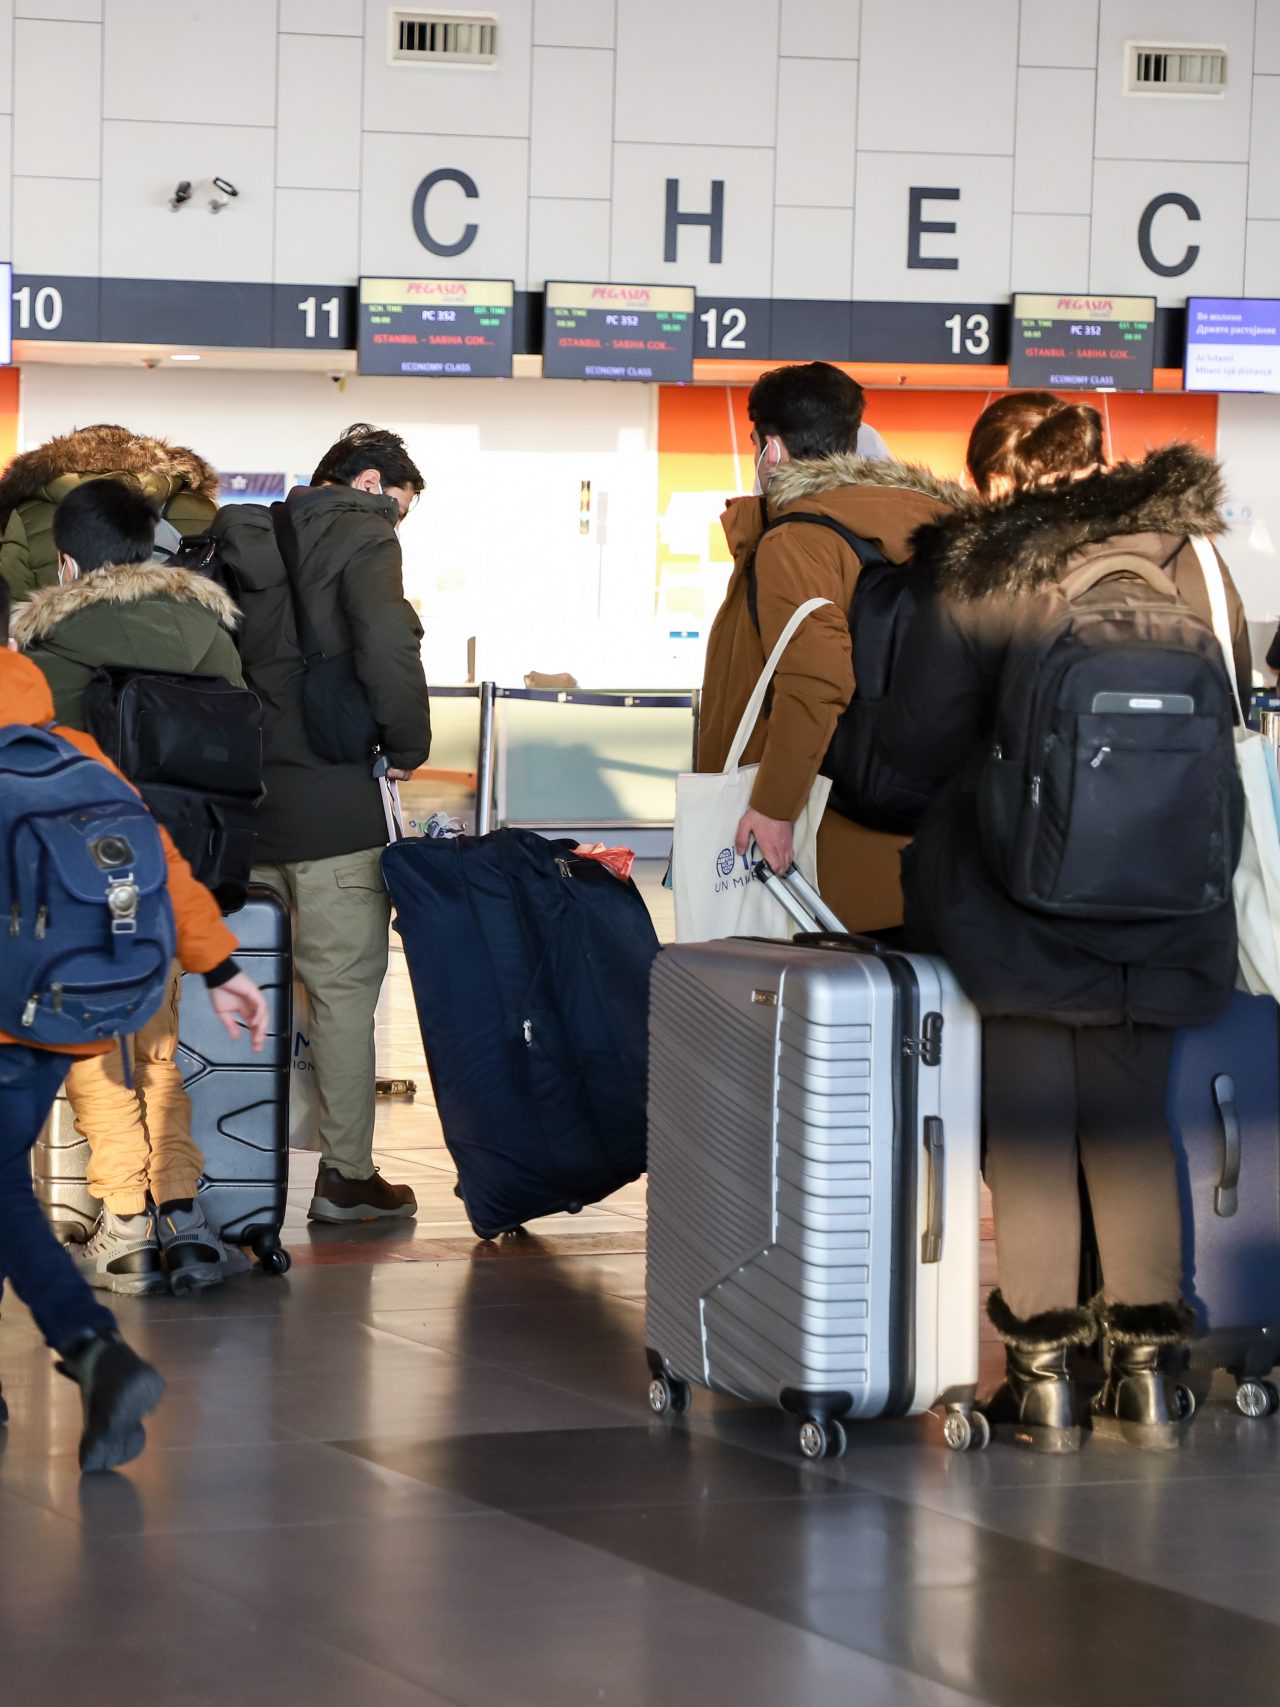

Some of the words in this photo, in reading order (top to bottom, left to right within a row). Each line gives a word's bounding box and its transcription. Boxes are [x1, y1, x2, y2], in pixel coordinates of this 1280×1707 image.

[406, 282, 468, 294] PEGASUS
[591, 287, 651, 300] PEGASUS
[12, 286, 63, 330] 10
[1056, 298, 1113, 310] PEGASUS
[297, 296, 339, 339] 11
[422, 310, 435, 321] PC
[437, 311, 456, 321] 352
[605, 314, 619, 325] PC
[621, 315, 639, 326] 352
[1209, 313, 1243, 321] молиме
[700, 308, 747, 349] 12
[945, 314, 990, 355] 13
[1070, 325, 1082, 335] PC
[1084, 325, 1102, 336] 352
[1196, 324, 1229, 335] Држете
[1230, 325, 1277, 336] растојание
[373, 334, 418, 344] ISTANBUL
[429, 335, 464, 344] SABIHA
[559, 337, 601, 348] ISTANBUL
[612, 339, 645, 349] SABIHA
[1025, 347, 1066, 358] ISTANBUL
[1077, 348, 1107, 359] SABIHA
[401, 361, 442, 372] ECONOMY
[444, 363, 471, 372] CLASS
[585, 365, 626, 376] ECONOMY
[627, 366, 652, 377] CLASS
[1050, 374, 1088, 384] ECONOMY
[1090, 375, 1114, 385] CLASS
[715, 880, 728, 893] UN
